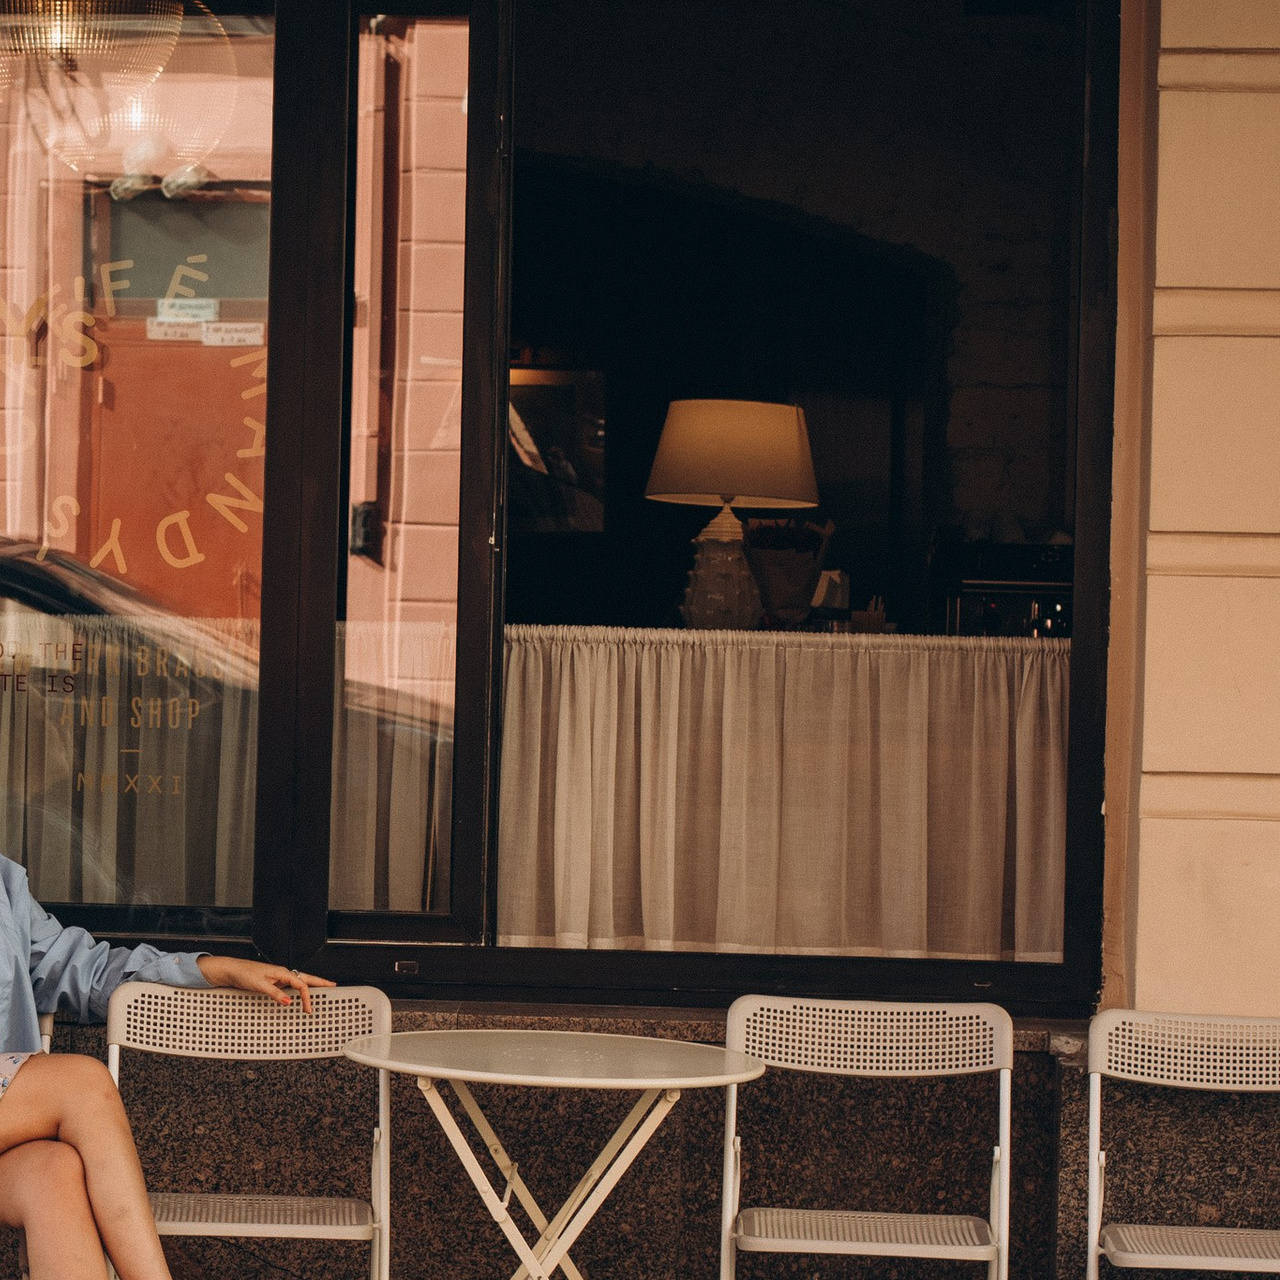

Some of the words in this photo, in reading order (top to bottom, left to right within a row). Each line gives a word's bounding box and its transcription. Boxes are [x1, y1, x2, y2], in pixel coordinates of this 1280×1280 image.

[39, 642, 83, 662] THE
[47, 675, 76, 694] IS
[59, 695, 115, 728] AND
[130, 696, 200, 730] SHOP
